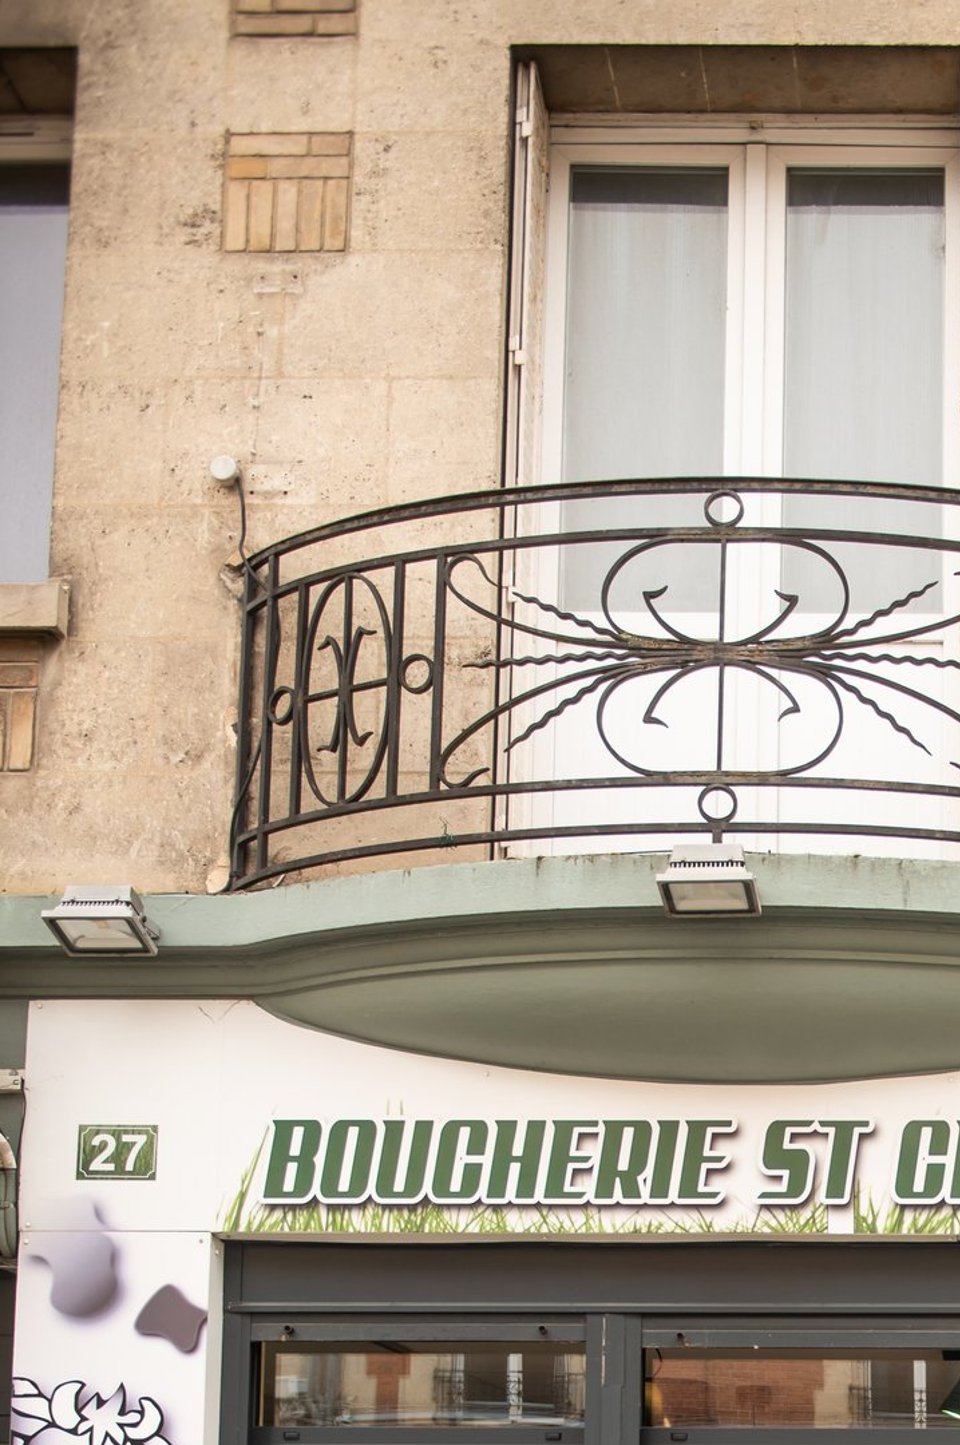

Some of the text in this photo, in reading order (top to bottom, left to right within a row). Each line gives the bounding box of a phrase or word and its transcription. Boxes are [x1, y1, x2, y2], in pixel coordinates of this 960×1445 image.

[89, 1132, 148, 1172] 27
[260, 1117, 737, 1204] BOUCHERIE
[757, 1117, 875, 1204] ST
